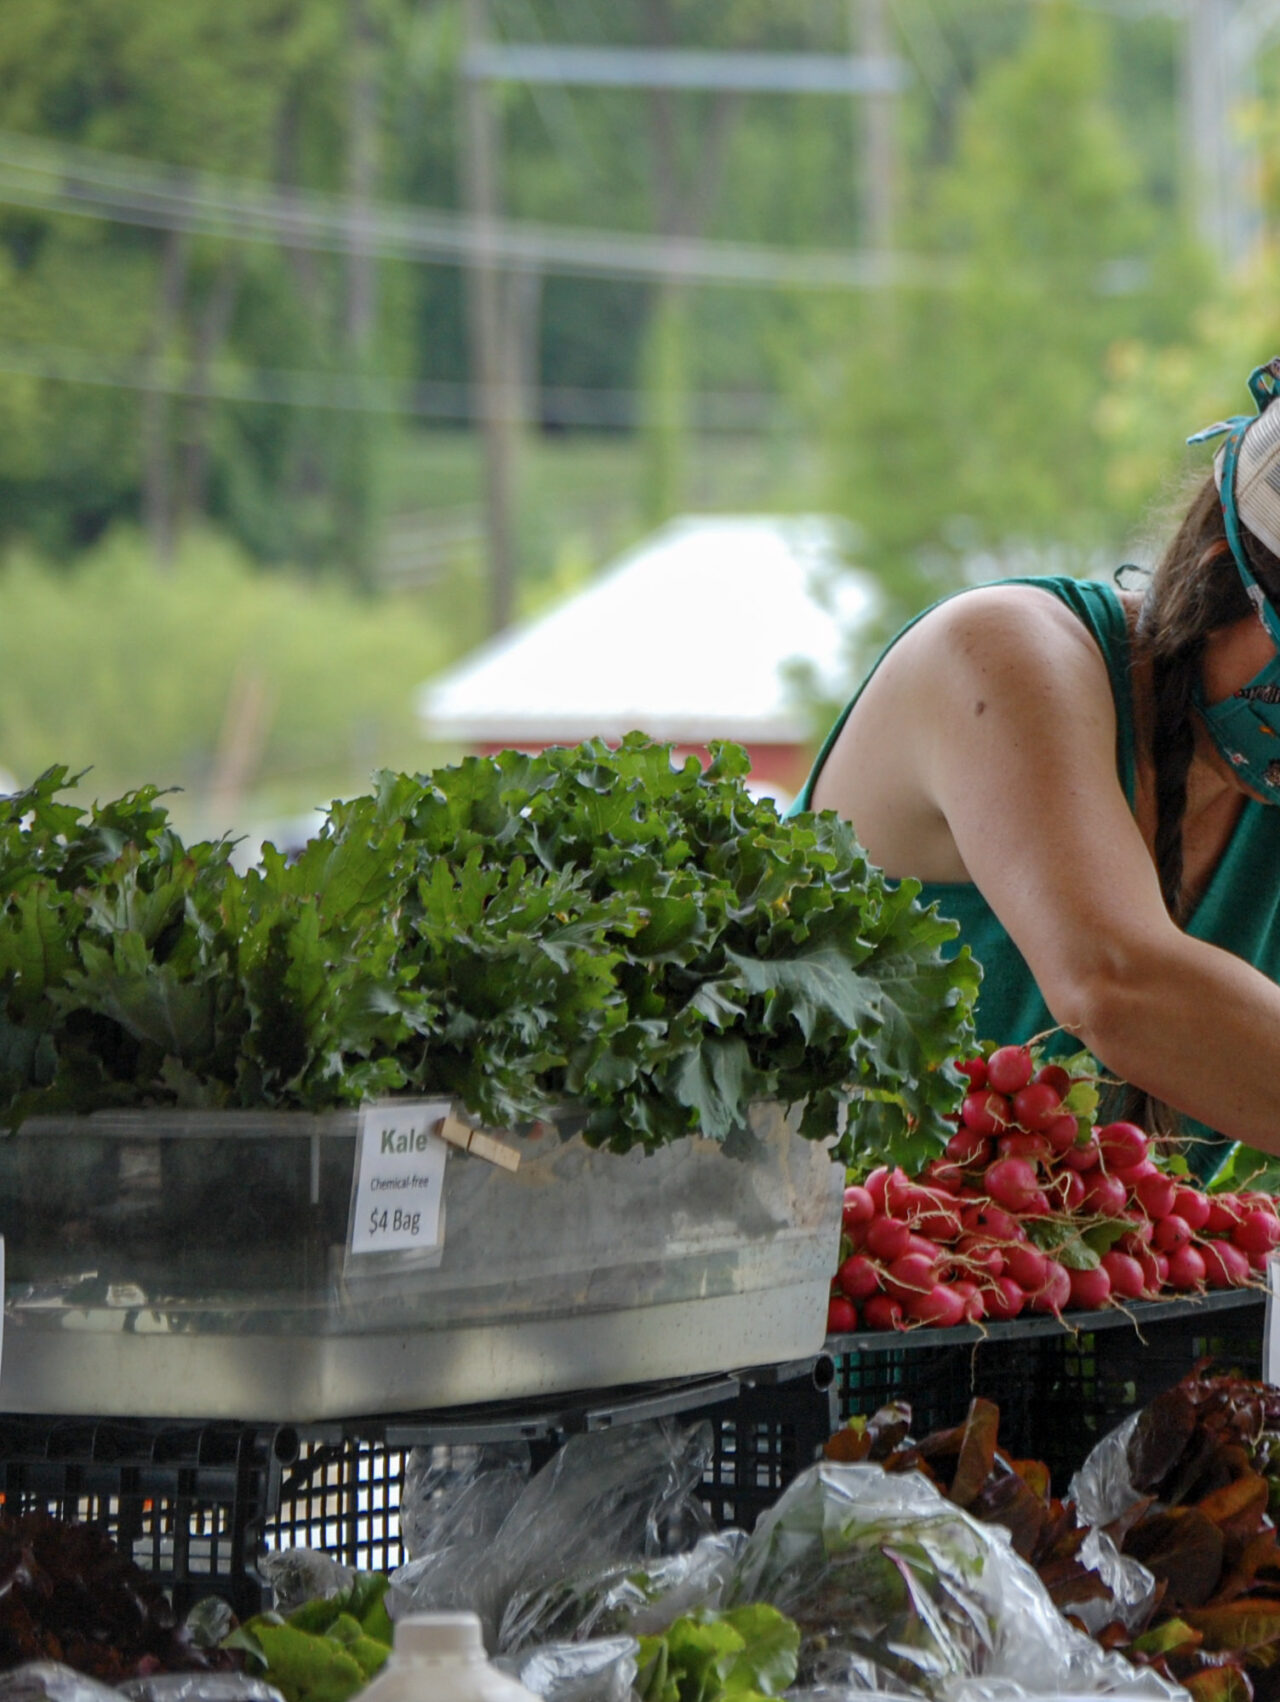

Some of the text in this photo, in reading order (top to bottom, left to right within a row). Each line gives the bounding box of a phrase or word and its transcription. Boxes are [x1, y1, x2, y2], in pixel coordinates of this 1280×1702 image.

[381, 1128, 428, 1154] Kale
[370, 1175, 429, 1192] Chemical-free
[369, 1207, 421, 1237] $4 Bag
